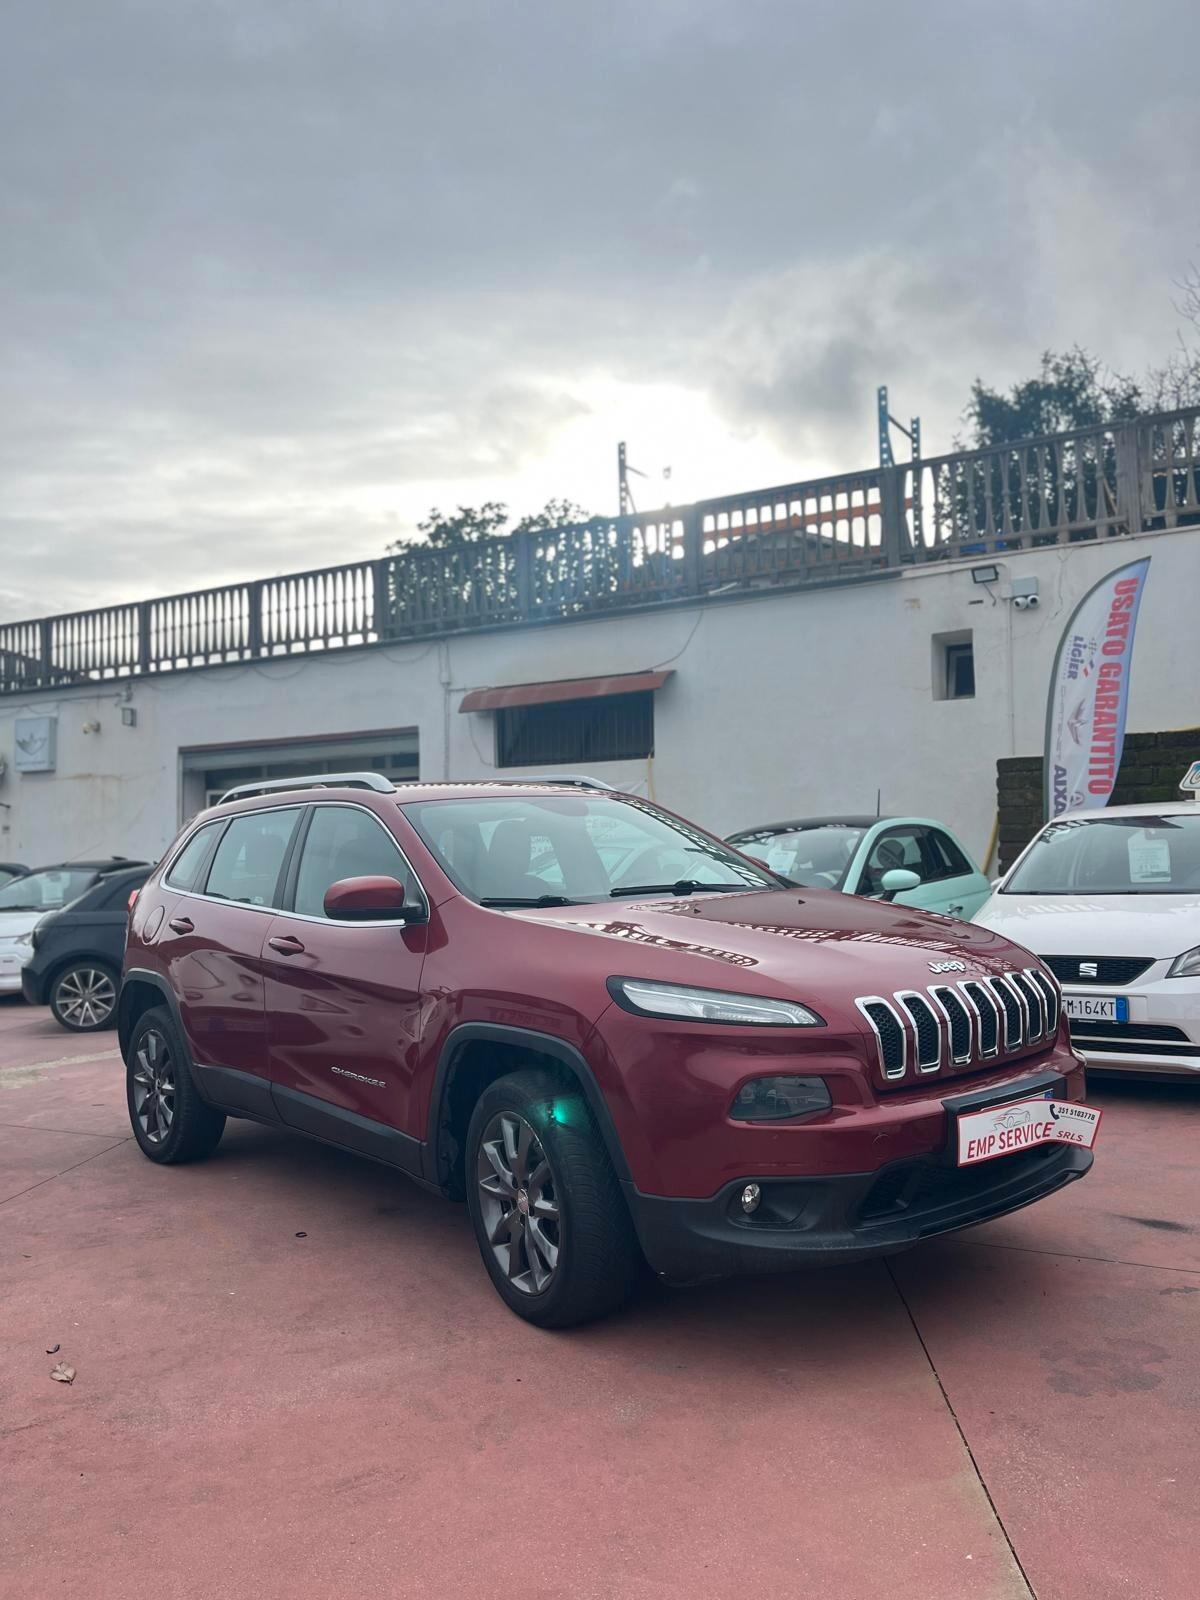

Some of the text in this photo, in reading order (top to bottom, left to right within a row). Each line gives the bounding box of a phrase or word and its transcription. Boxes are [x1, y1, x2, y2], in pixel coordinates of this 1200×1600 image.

[1088, 578, 1139, 795] USATO GARANTITO
[927, 960, 966, 974] Jeep
[967, 1122, 1083, 1159] EMP SERVICE SRLS
